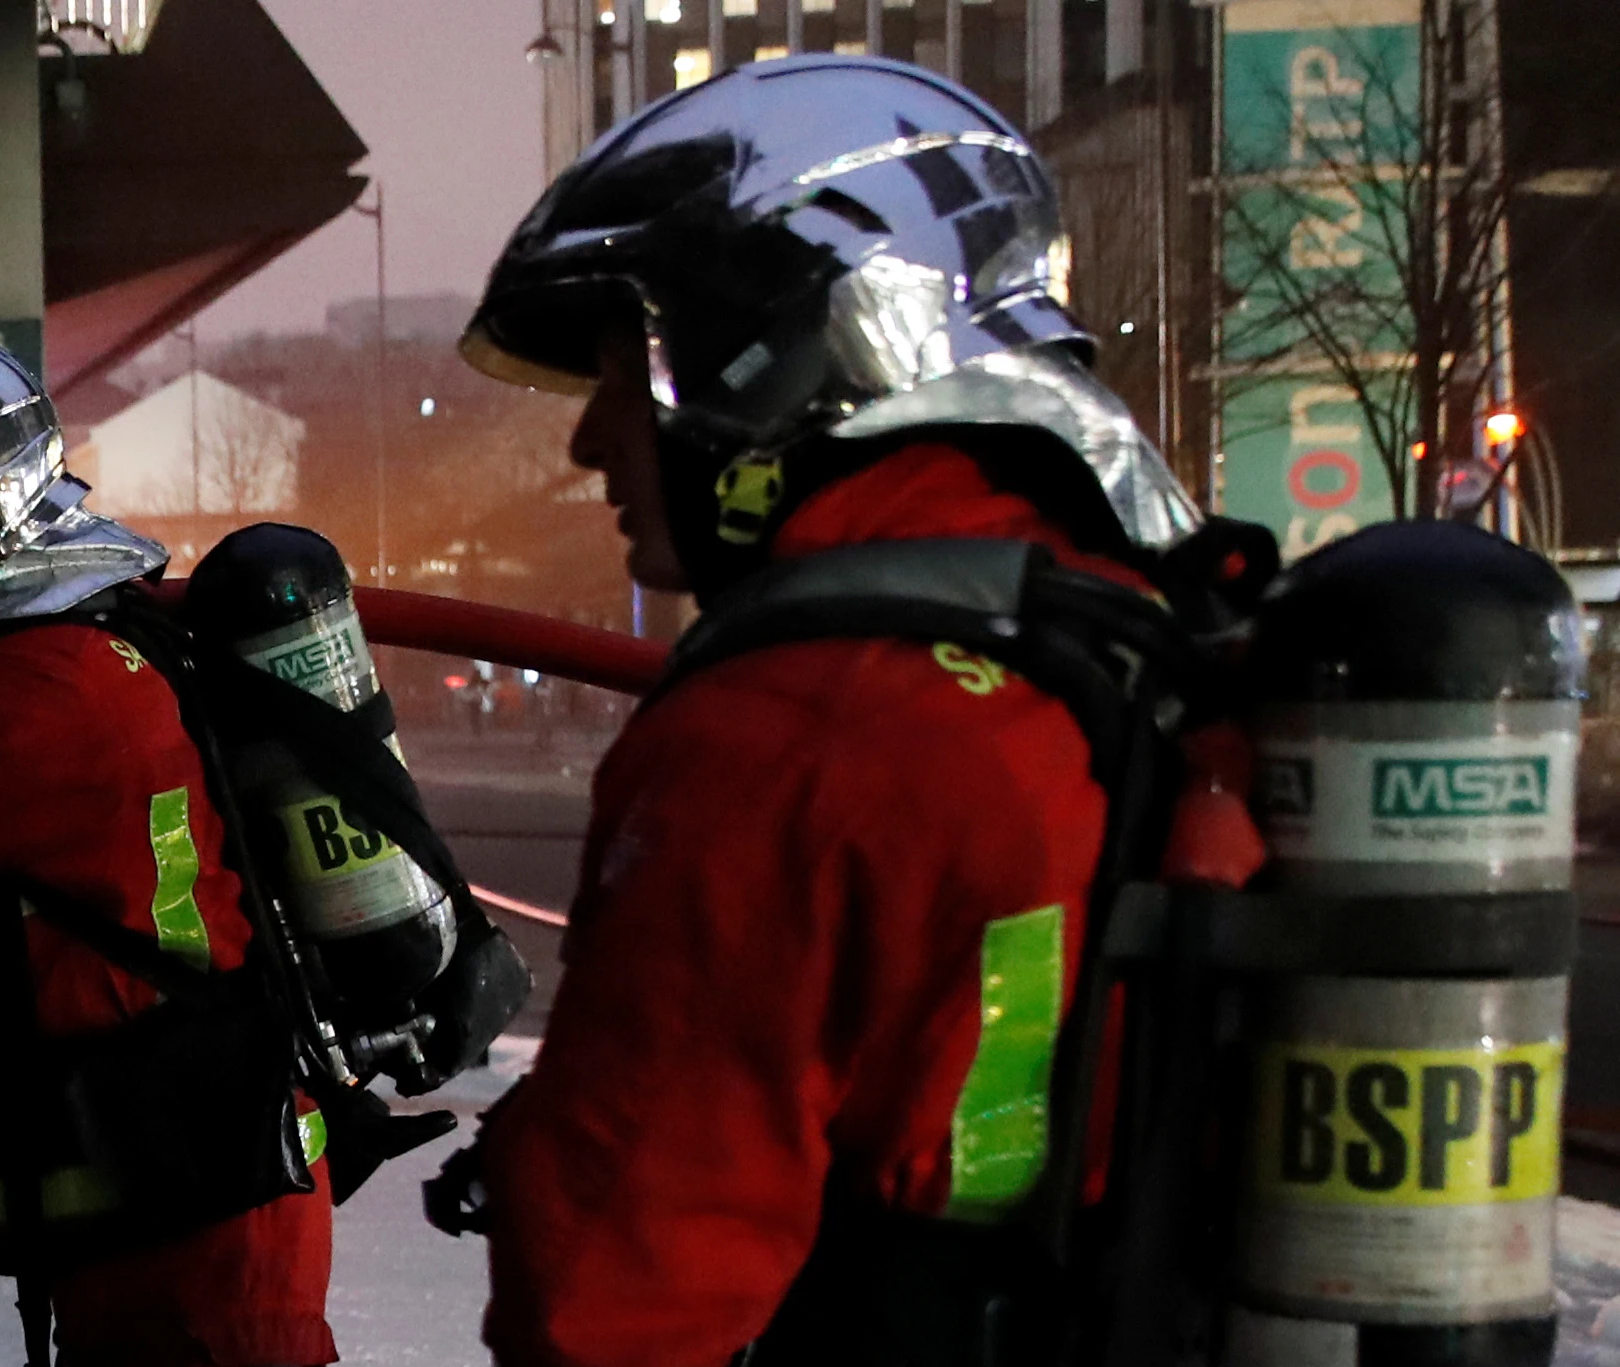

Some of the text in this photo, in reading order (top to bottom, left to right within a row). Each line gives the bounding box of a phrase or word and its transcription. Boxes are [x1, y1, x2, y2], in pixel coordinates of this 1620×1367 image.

[1380, 763, 1544, 812] MSA
[303, 804, 391, 872] BS
[1280, 1060, 1536, 1190] BSPP
